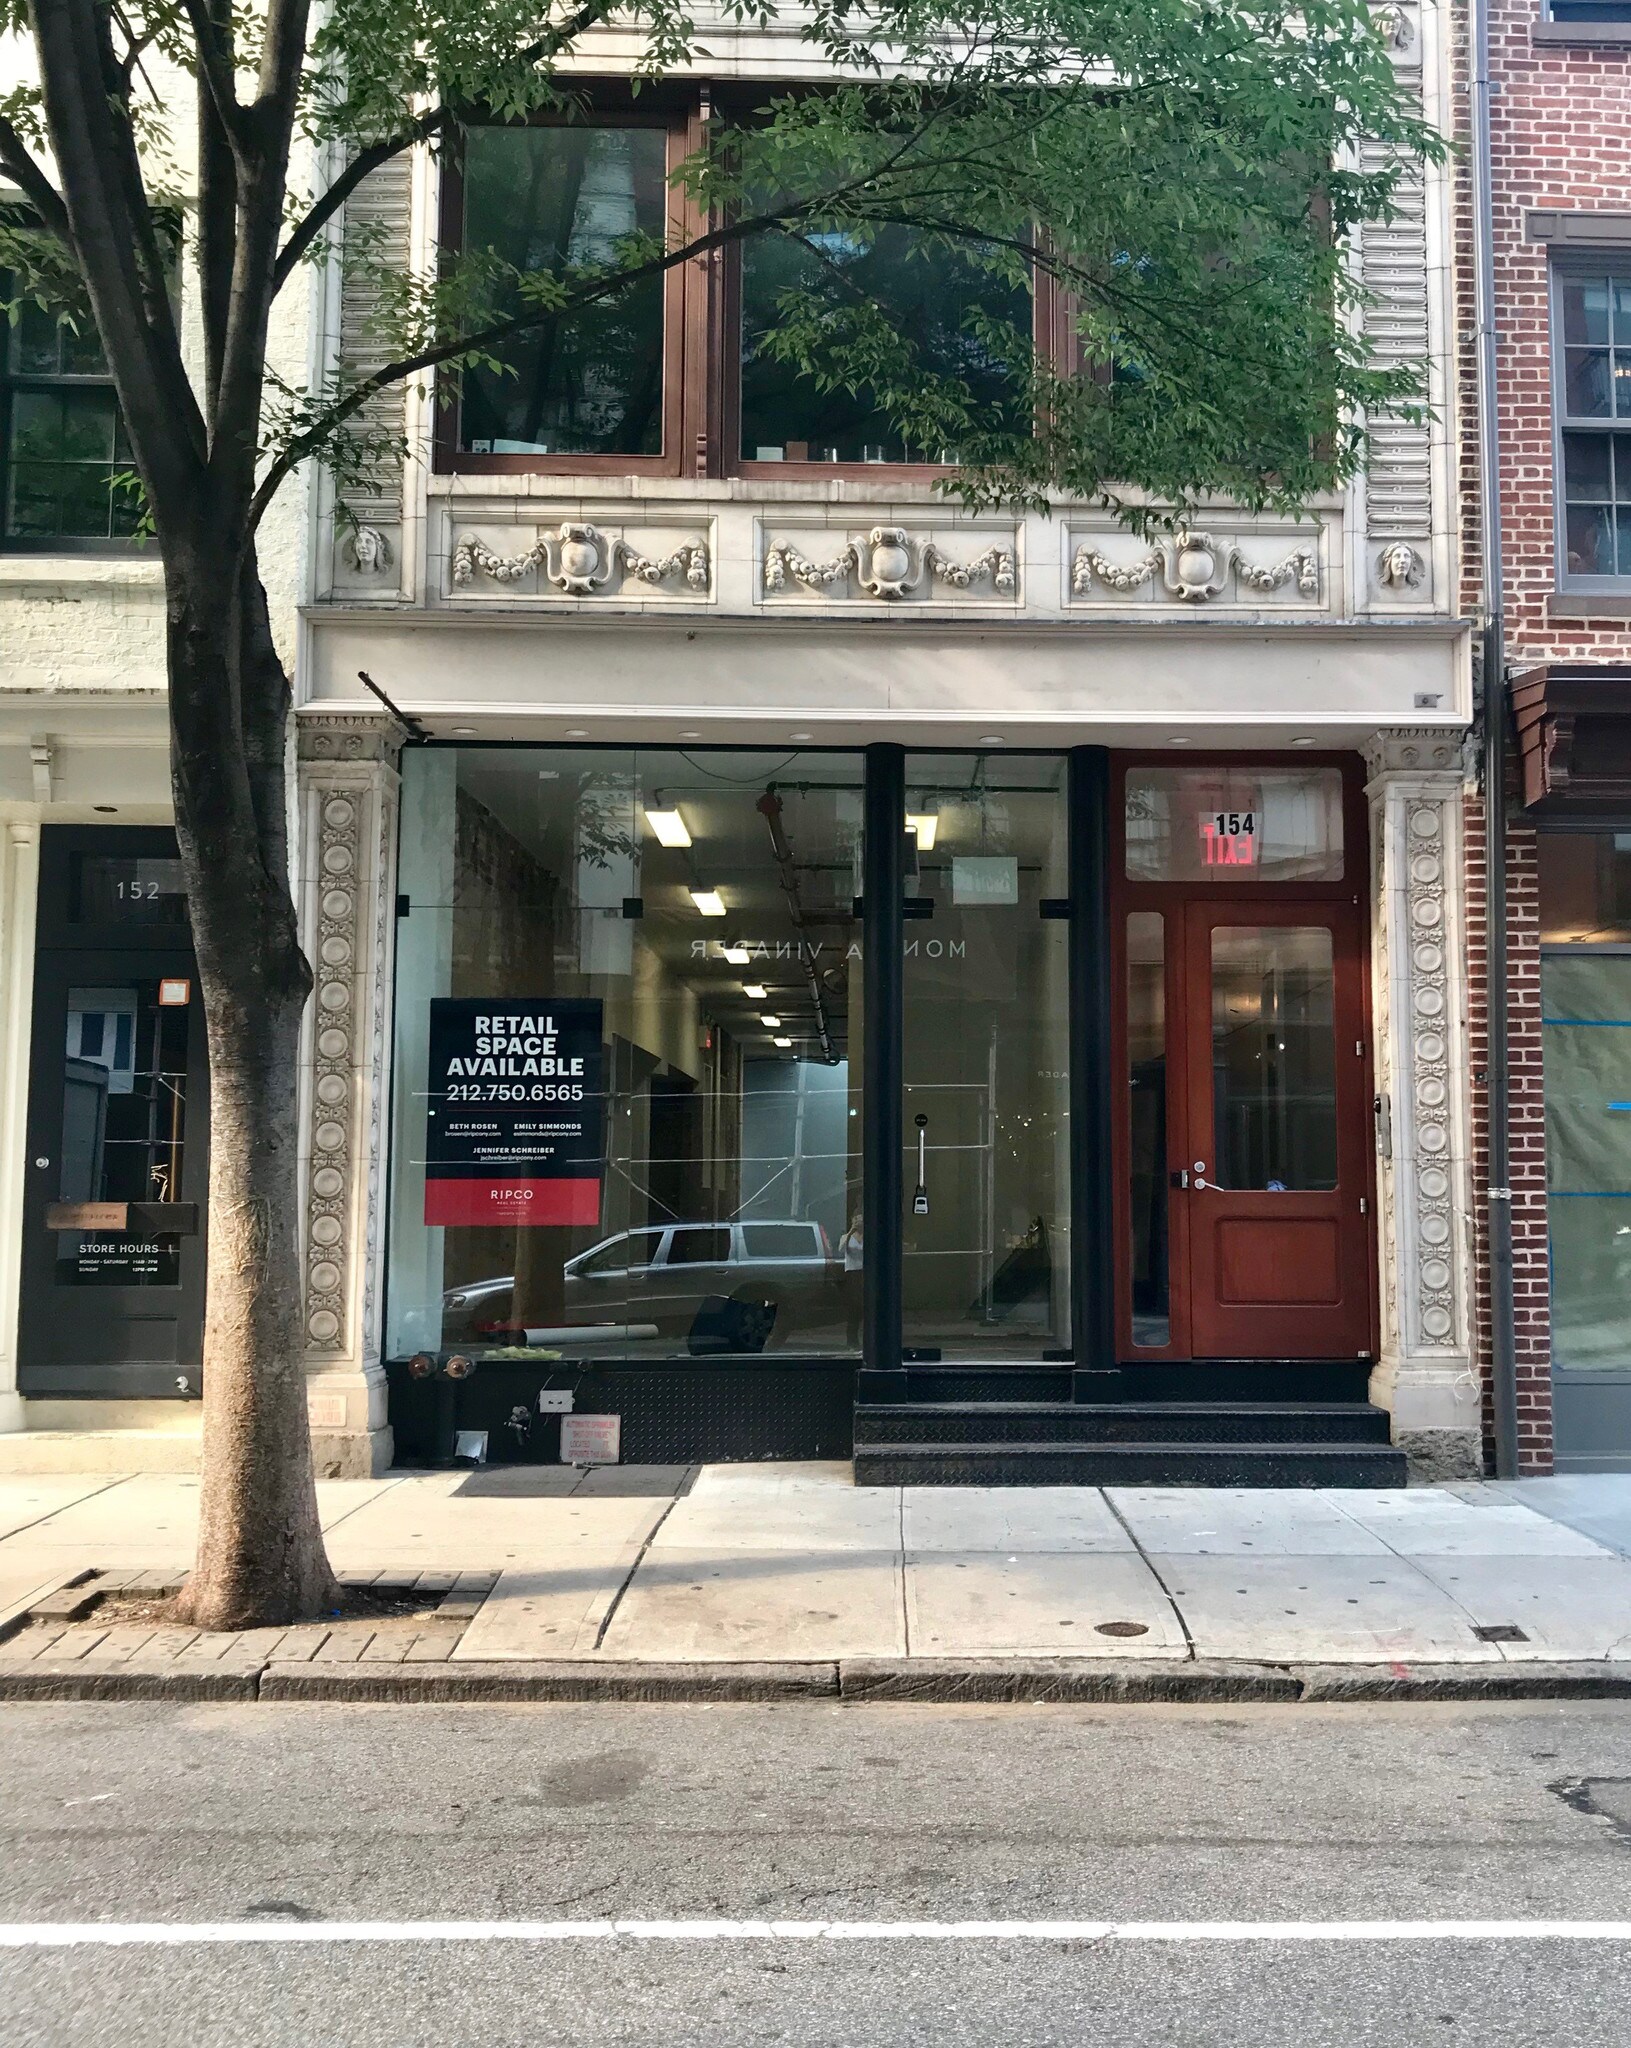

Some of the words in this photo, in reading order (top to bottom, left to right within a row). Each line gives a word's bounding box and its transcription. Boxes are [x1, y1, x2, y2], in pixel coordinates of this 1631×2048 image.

[1216, 813, 1255, 836] 154
[116, 881, 160, 900] 152
[475, 1016, 559, 1035] RETAIL
[475, 1037, 557, 1056] SPACE
[446, 1058, 585, 1076] AVAILABLE
[446, 1084, 584, 1101] 212.750.6565
[490, 1189, 534, 1200] RIPCO
[79, 1244, 116, 1253] STORE
[119, 1244, 159, 1253] HOURS
